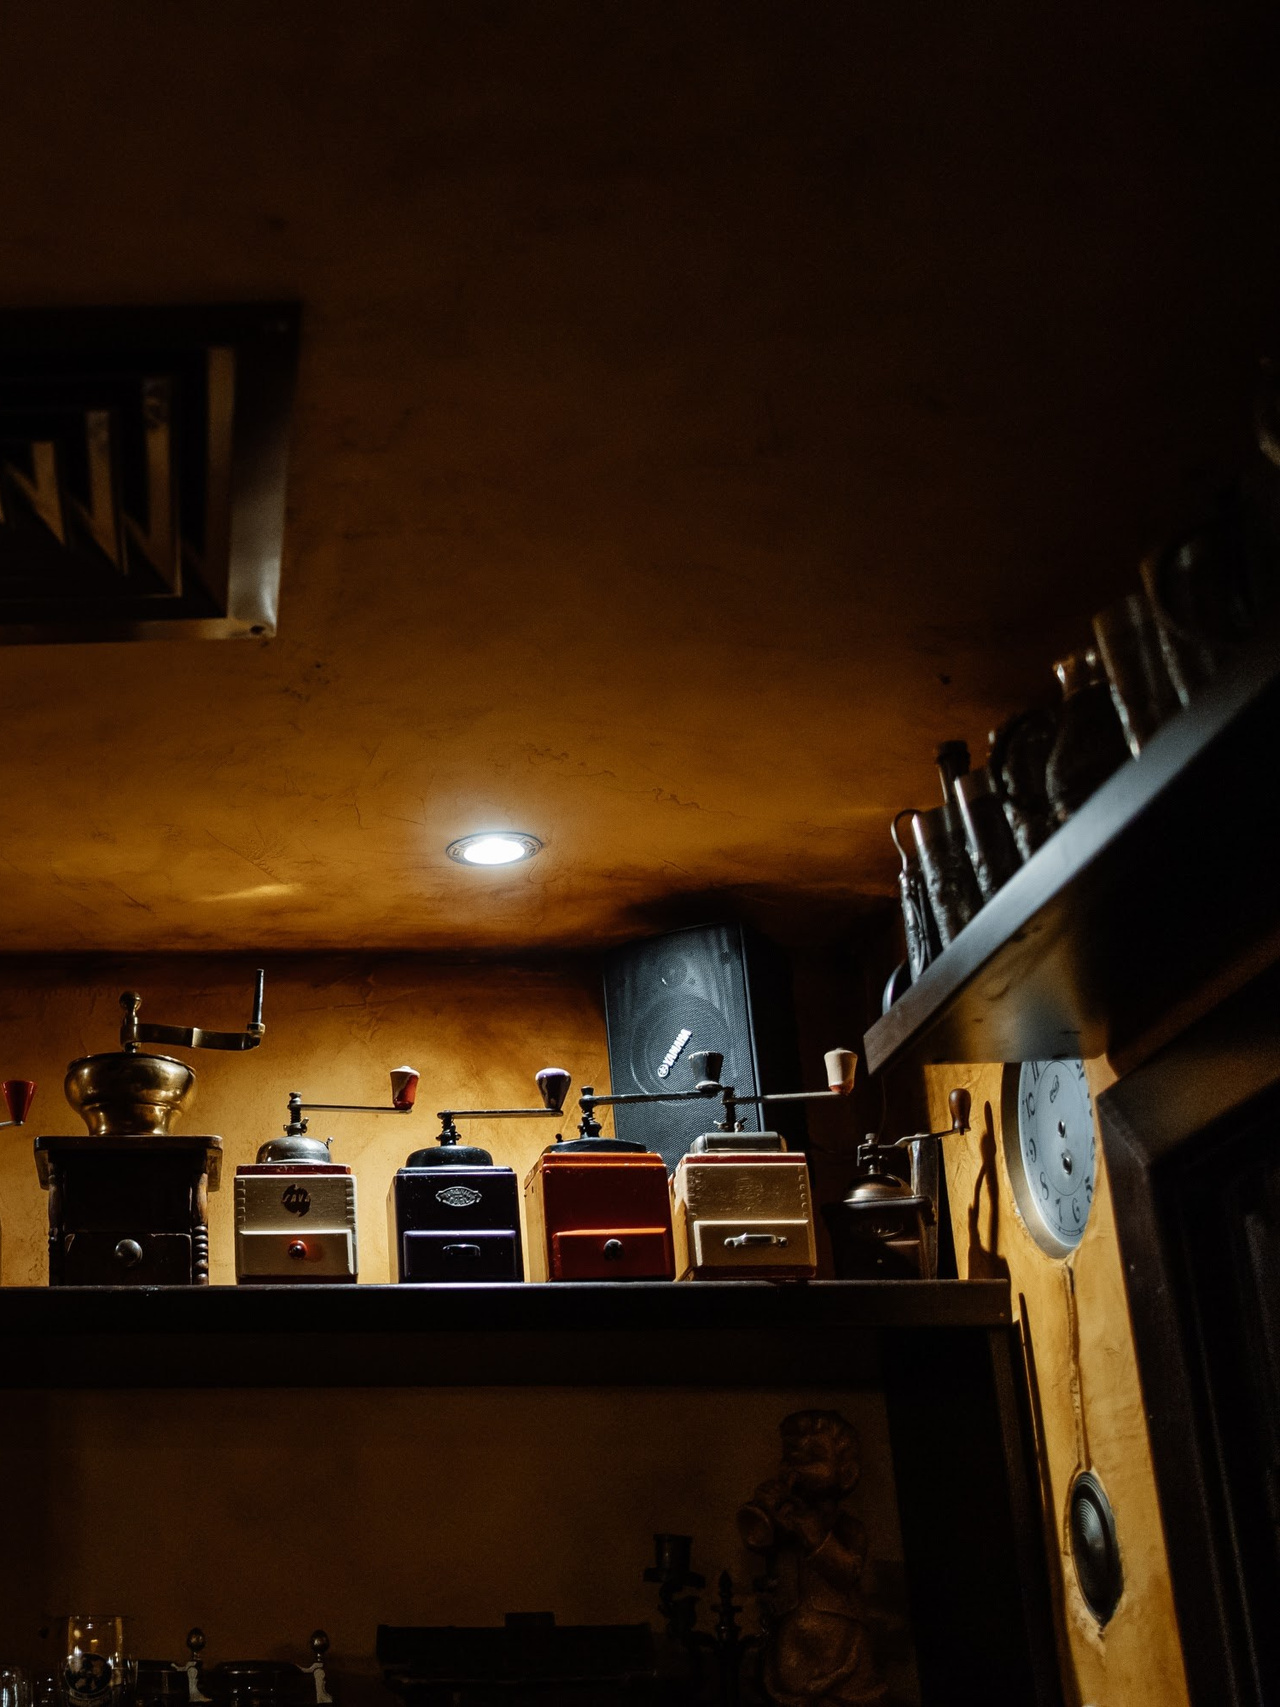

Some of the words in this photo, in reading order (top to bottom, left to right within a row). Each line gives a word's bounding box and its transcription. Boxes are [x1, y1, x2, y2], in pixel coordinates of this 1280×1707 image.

[662, 1028, 692, 1067] YAMAHA
[1025, 1092, 1036, 1120] 10
[1028, 1138, 1037, 1163] 9
[1040, 1171, 1049, 1201] 8
[1055, 1198, 1062, 1223] 7
[1071, 1197, 1080, 1223] 6
